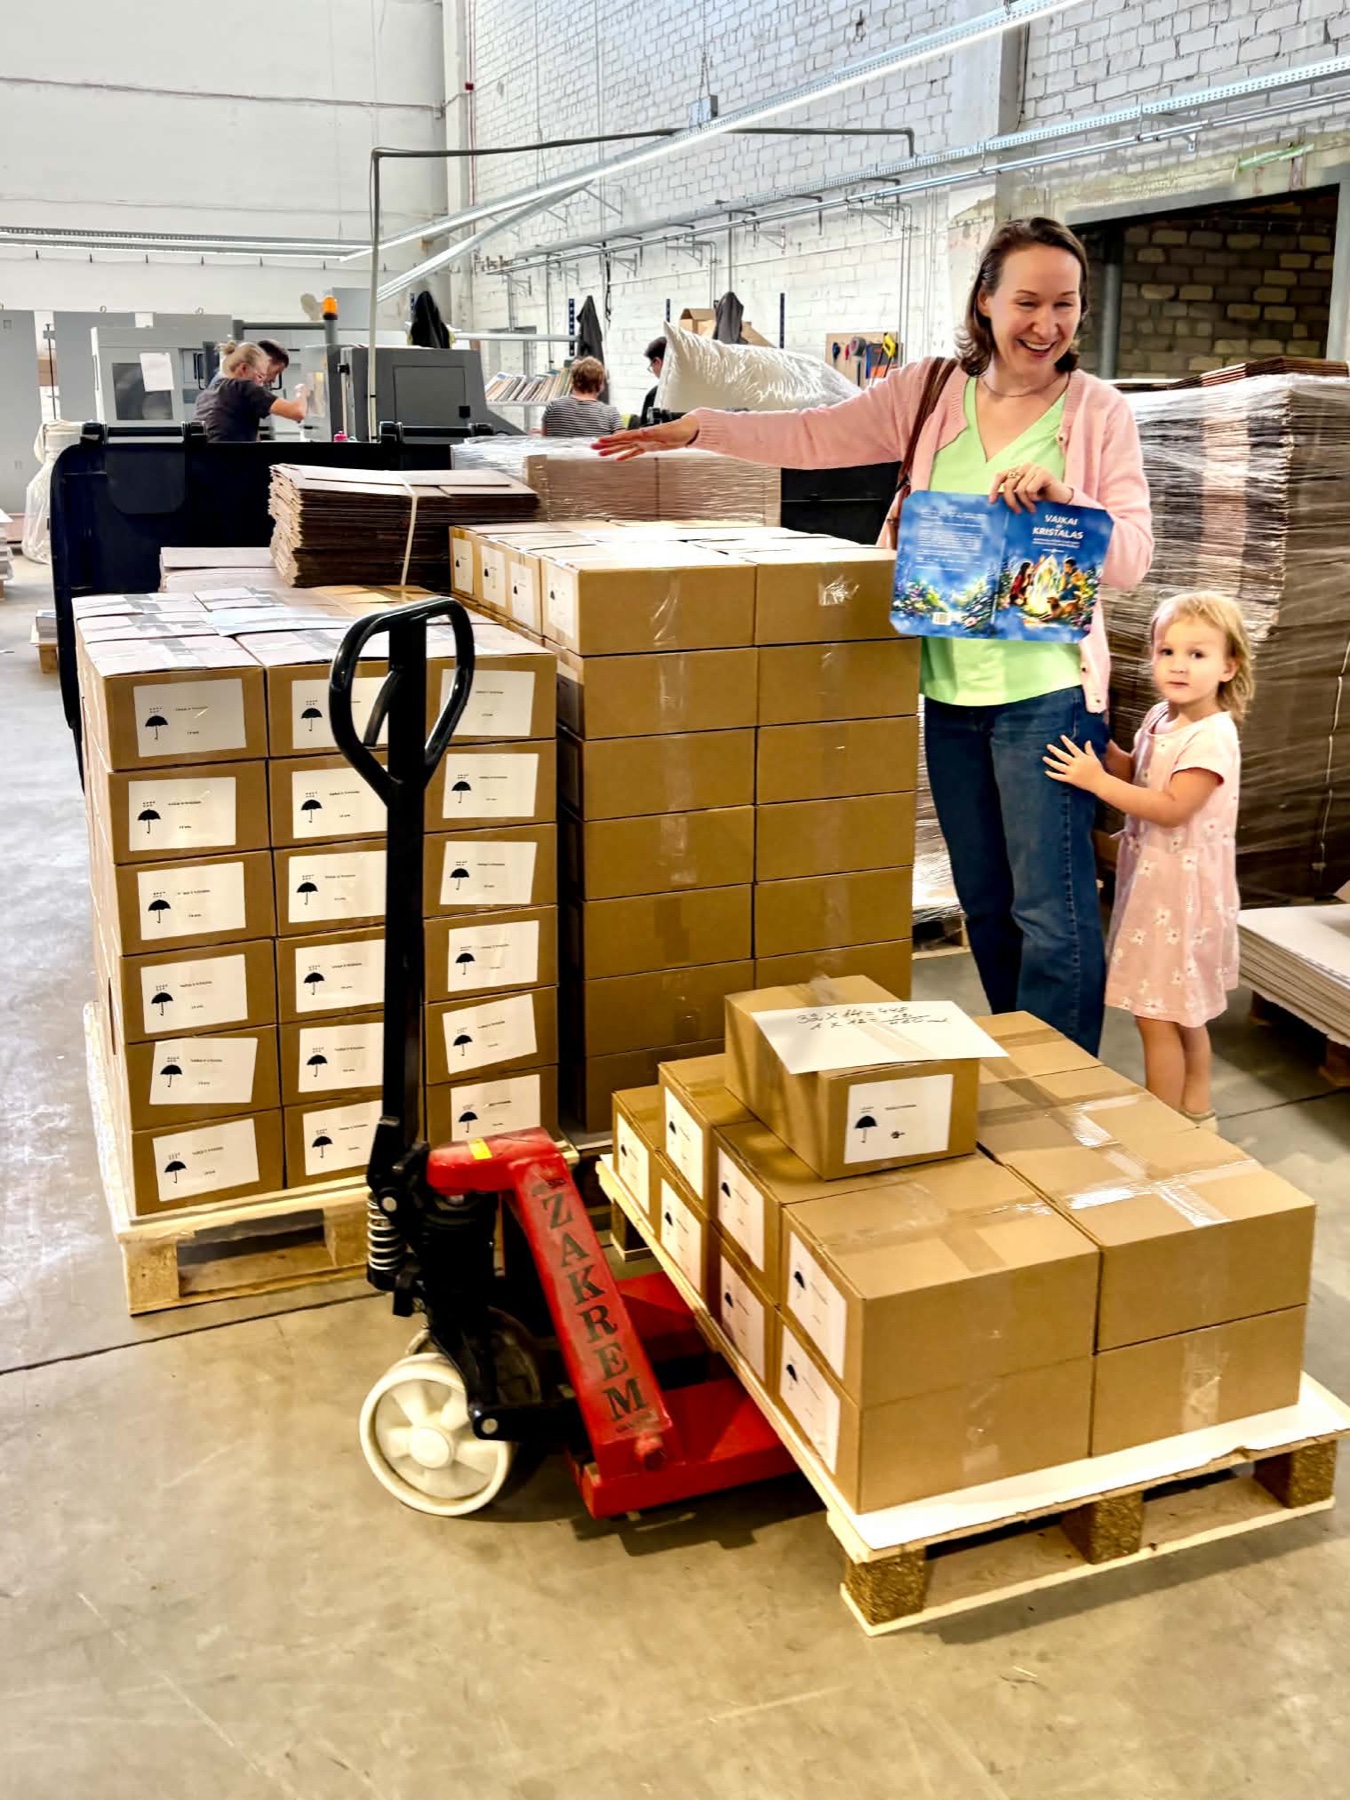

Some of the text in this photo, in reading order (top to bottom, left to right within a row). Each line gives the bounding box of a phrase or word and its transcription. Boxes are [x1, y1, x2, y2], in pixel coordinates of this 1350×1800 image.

[1045, 514, 1078, 525] VAIKAI
[1032, 527, 1084, 540] KRISTALAS
[542, 1192, 647, 1422] ZAKREM
